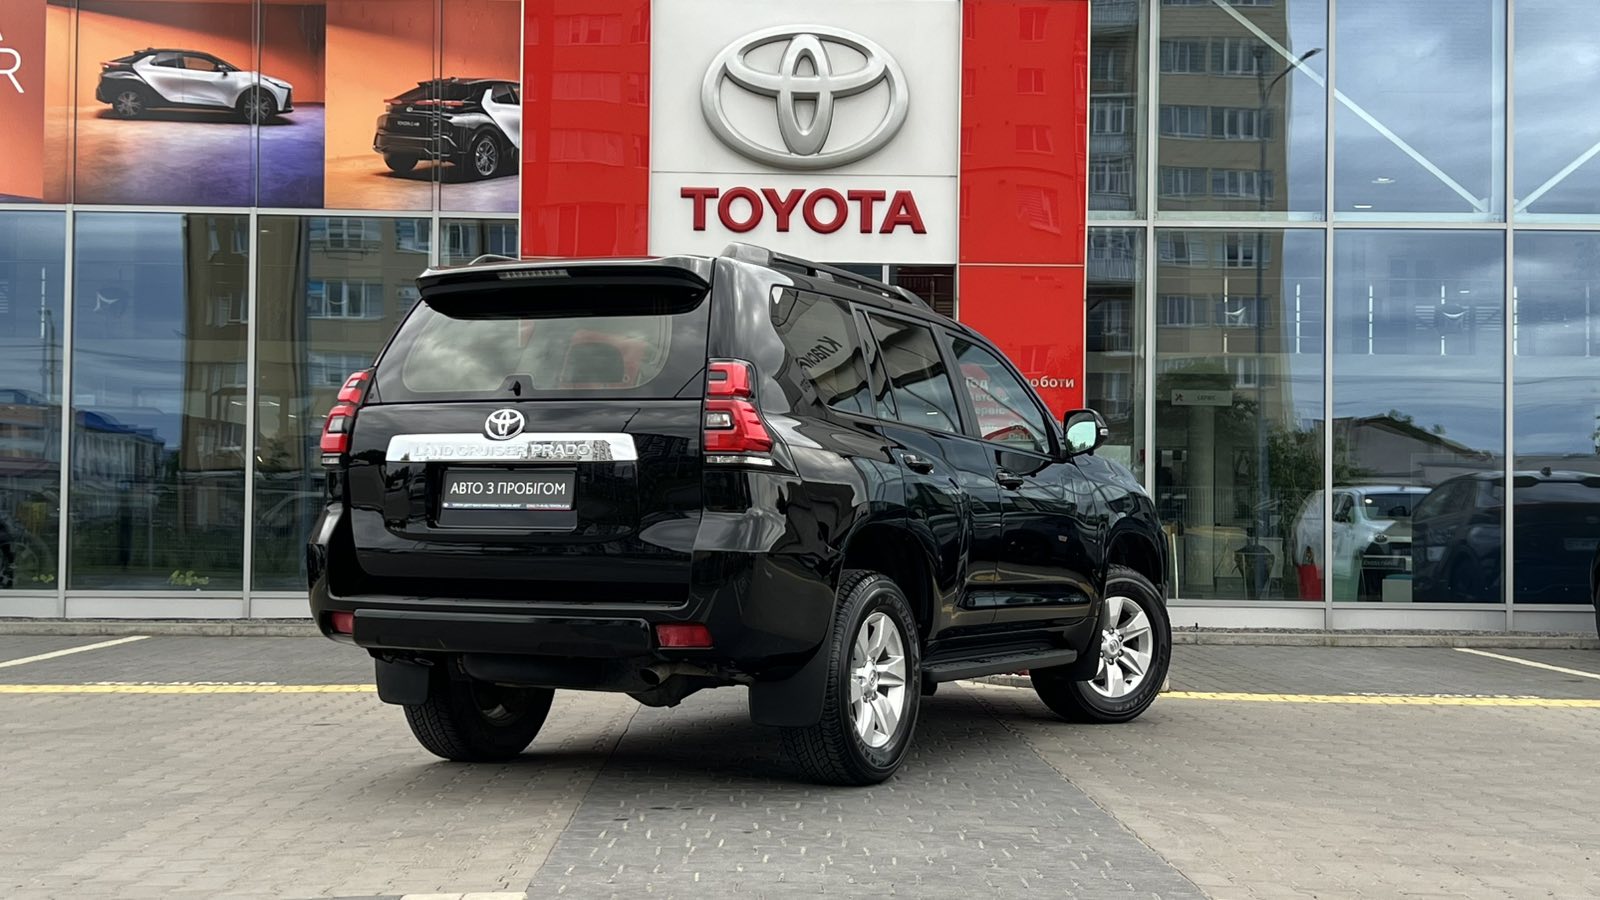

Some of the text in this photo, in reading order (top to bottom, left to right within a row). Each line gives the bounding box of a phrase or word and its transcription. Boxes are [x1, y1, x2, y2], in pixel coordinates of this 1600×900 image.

[681, 186, 927, 235] TOYOTA
[414, 443, 592, 457] LAND CRUISER PRADO
[450, 482, 566, 495] АВТО З ПРОБІГОМ
